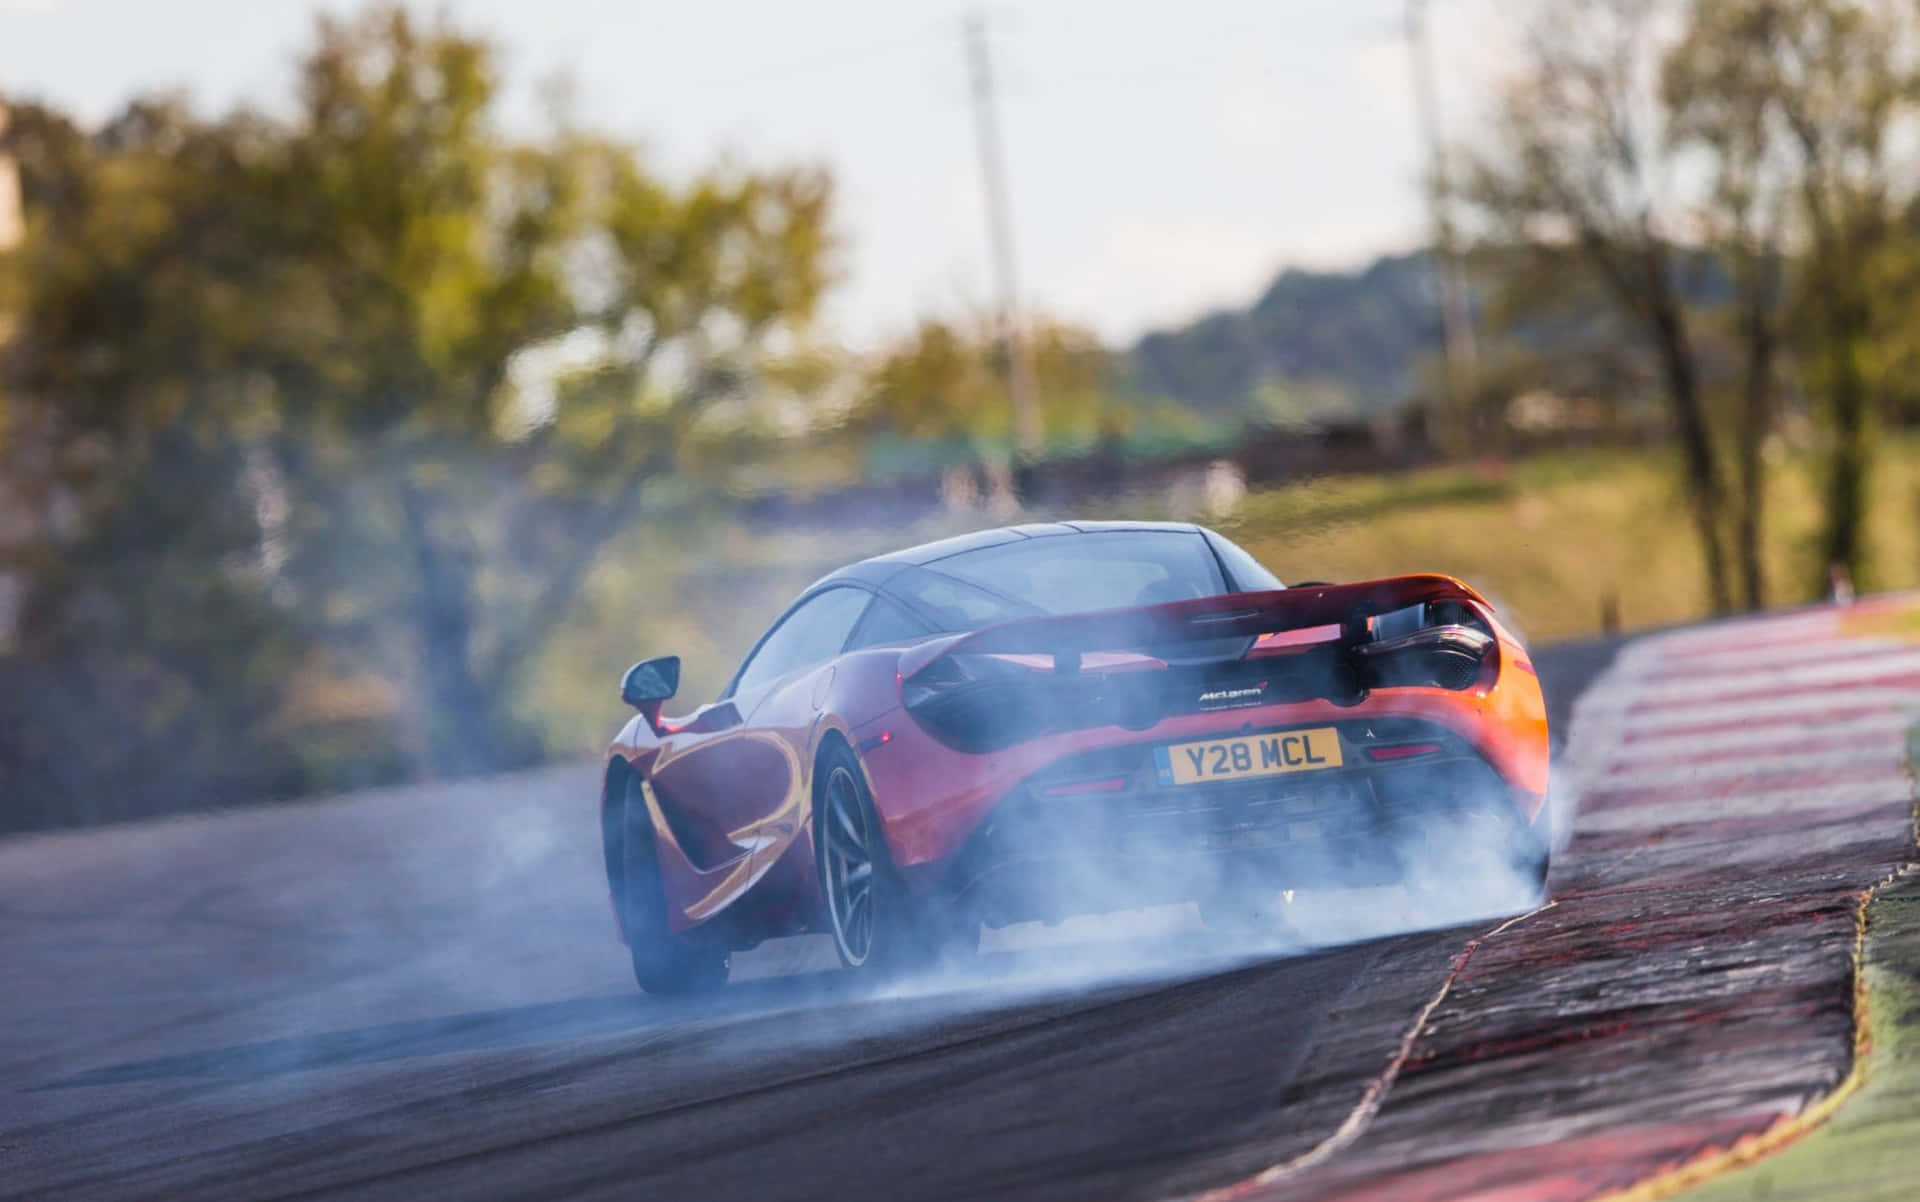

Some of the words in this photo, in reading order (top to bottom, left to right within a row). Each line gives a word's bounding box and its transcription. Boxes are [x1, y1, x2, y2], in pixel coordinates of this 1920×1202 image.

[1199, 687, 1262, 701] McLaren
[1186, 742, 1253, 777] Y28
[1260, 735, 1326, 769] MCL
